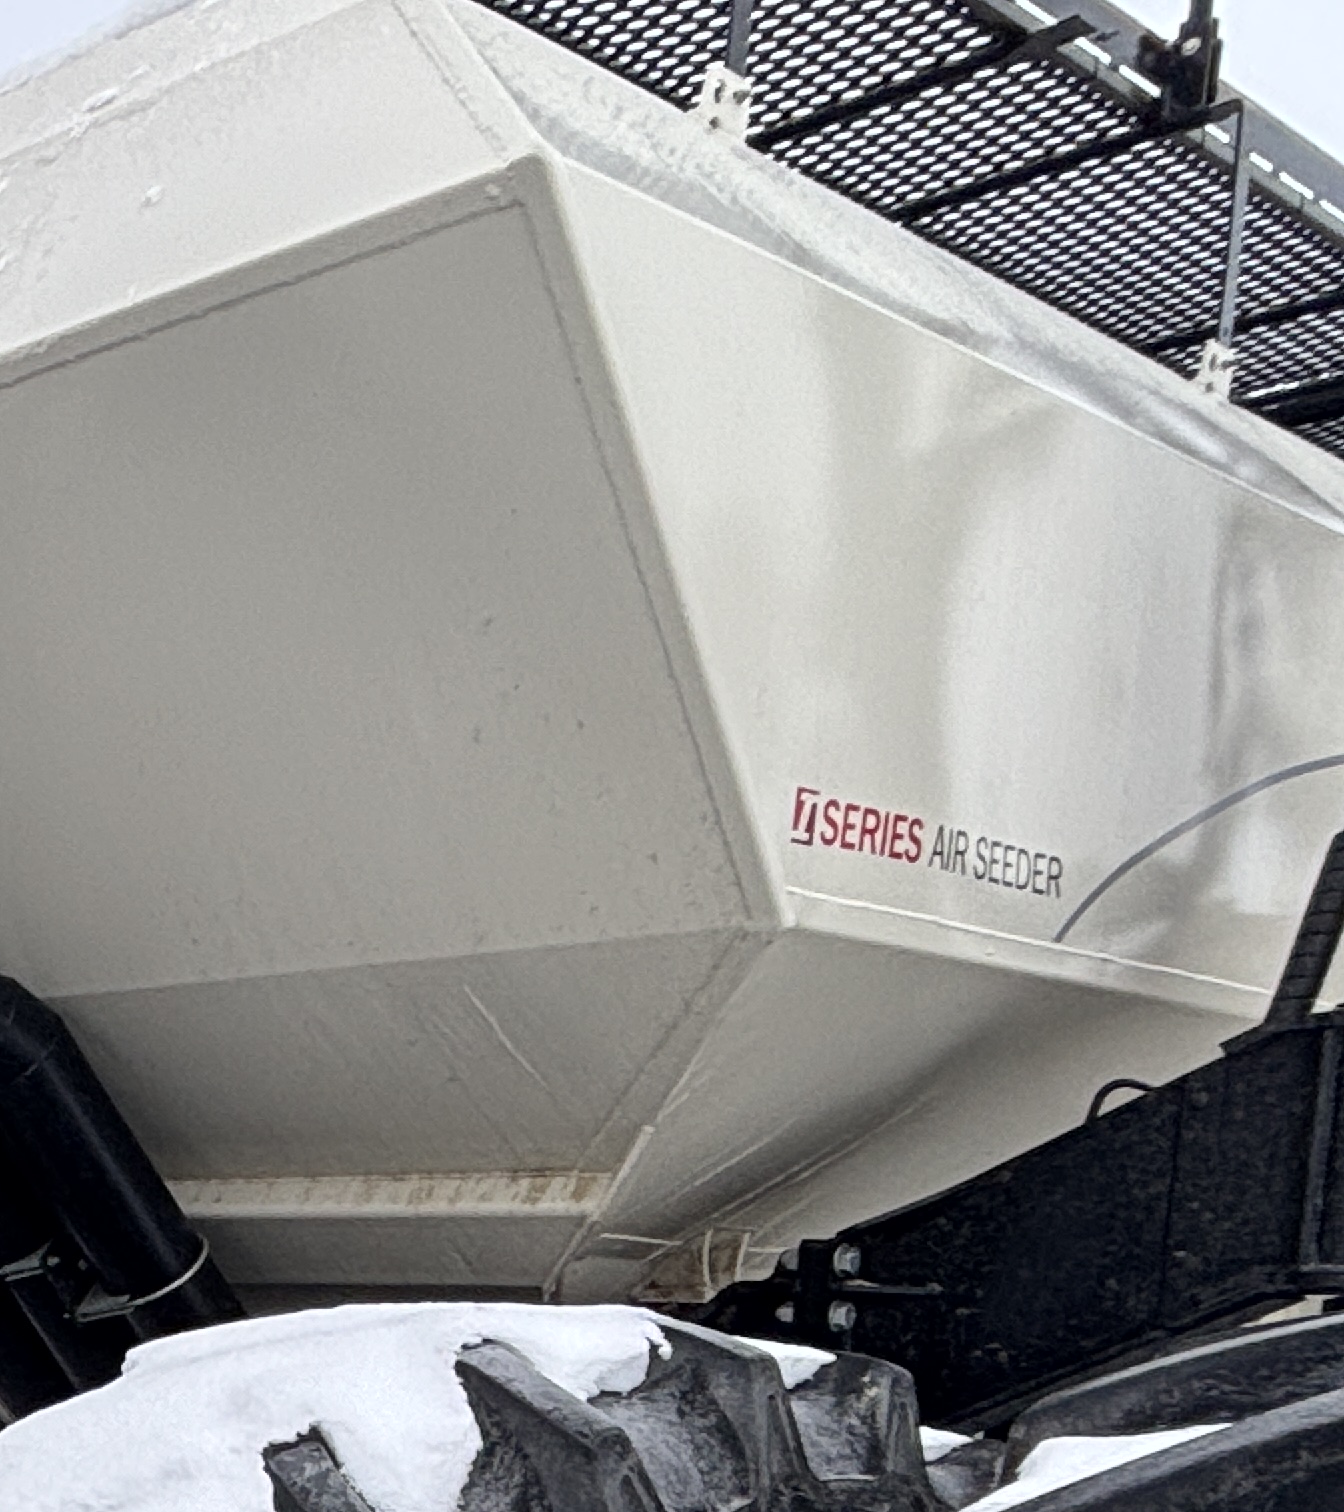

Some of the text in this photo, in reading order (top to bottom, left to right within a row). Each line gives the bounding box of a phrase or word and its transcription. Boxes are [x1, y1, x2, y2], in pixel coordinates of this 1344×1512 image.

[820, 798, 925, 864] SERIES
[928, 824, 970, 876] AIR
[972, 836, 1064, 899] SEEDER
